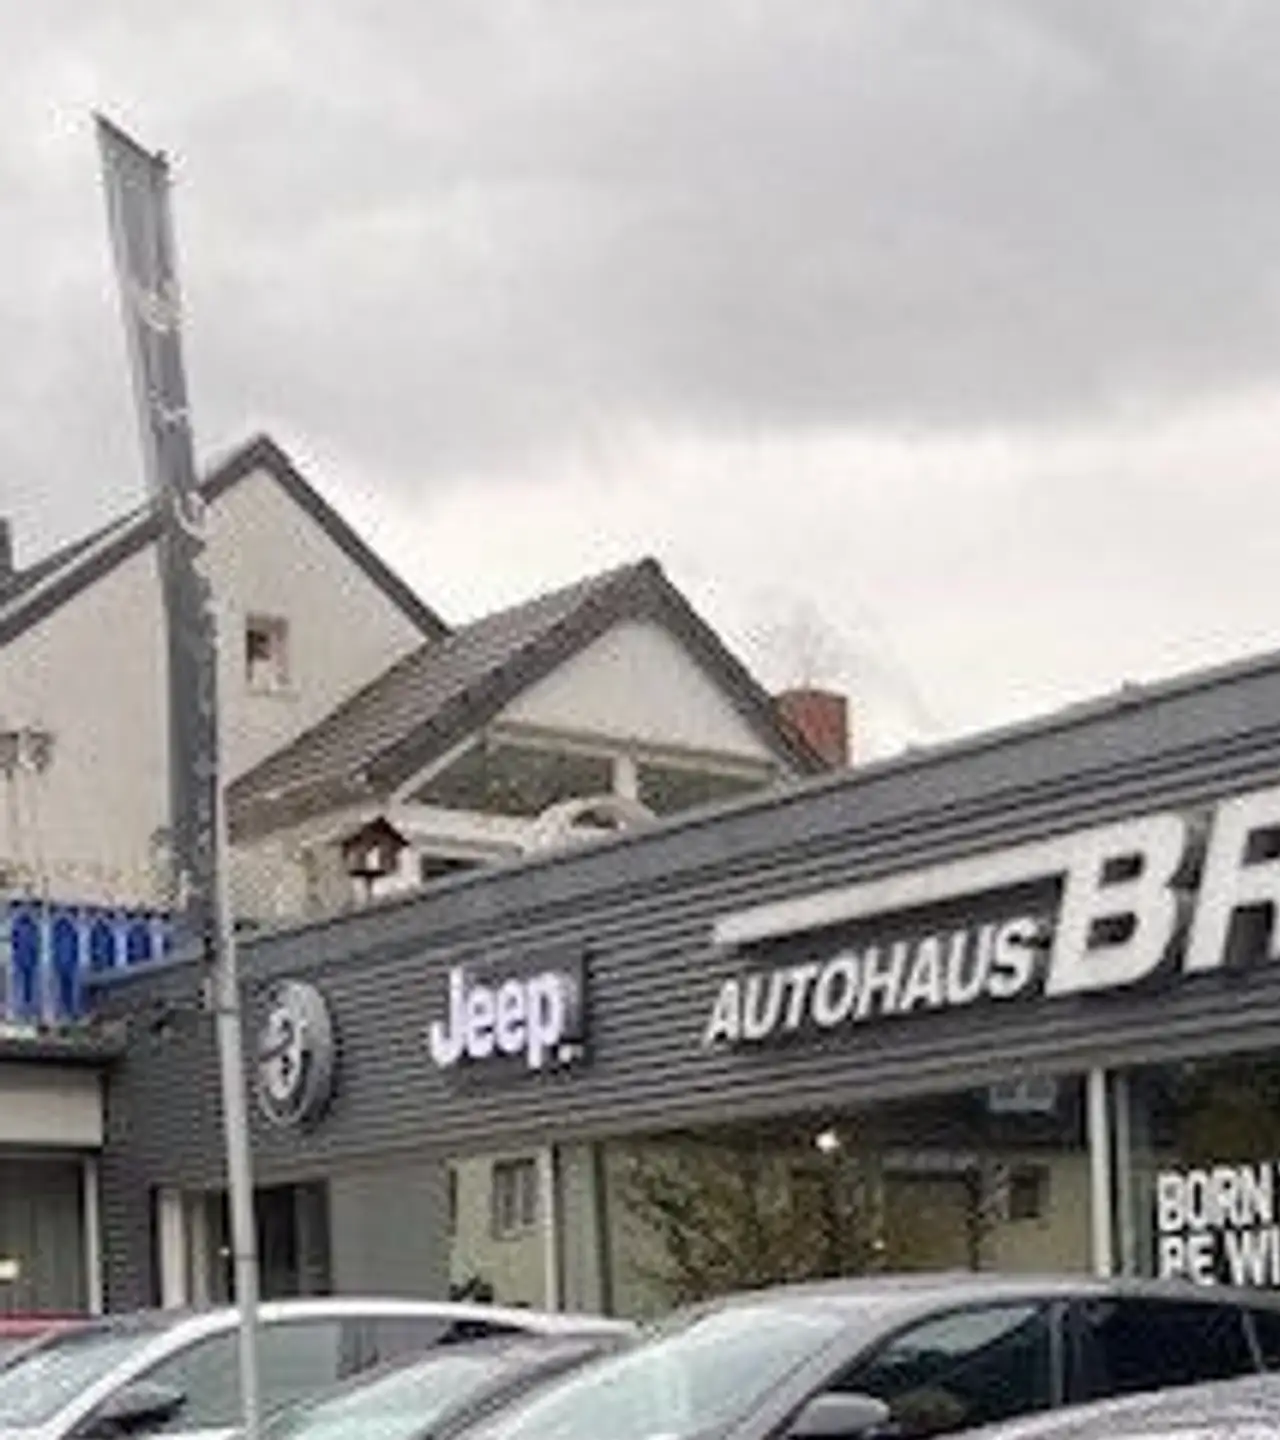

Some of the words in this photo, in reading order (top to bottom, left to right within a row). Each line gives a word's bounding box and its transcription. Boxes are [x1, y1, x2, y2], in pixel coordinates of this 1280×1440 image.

[429, 964, 564, 1069] Jeep
[702, 916, 1040, 1053] AUTOHAUS
[1157, 1163, 1273, 1232] BORN
[1158, 1233, 1216, 1287] BE
